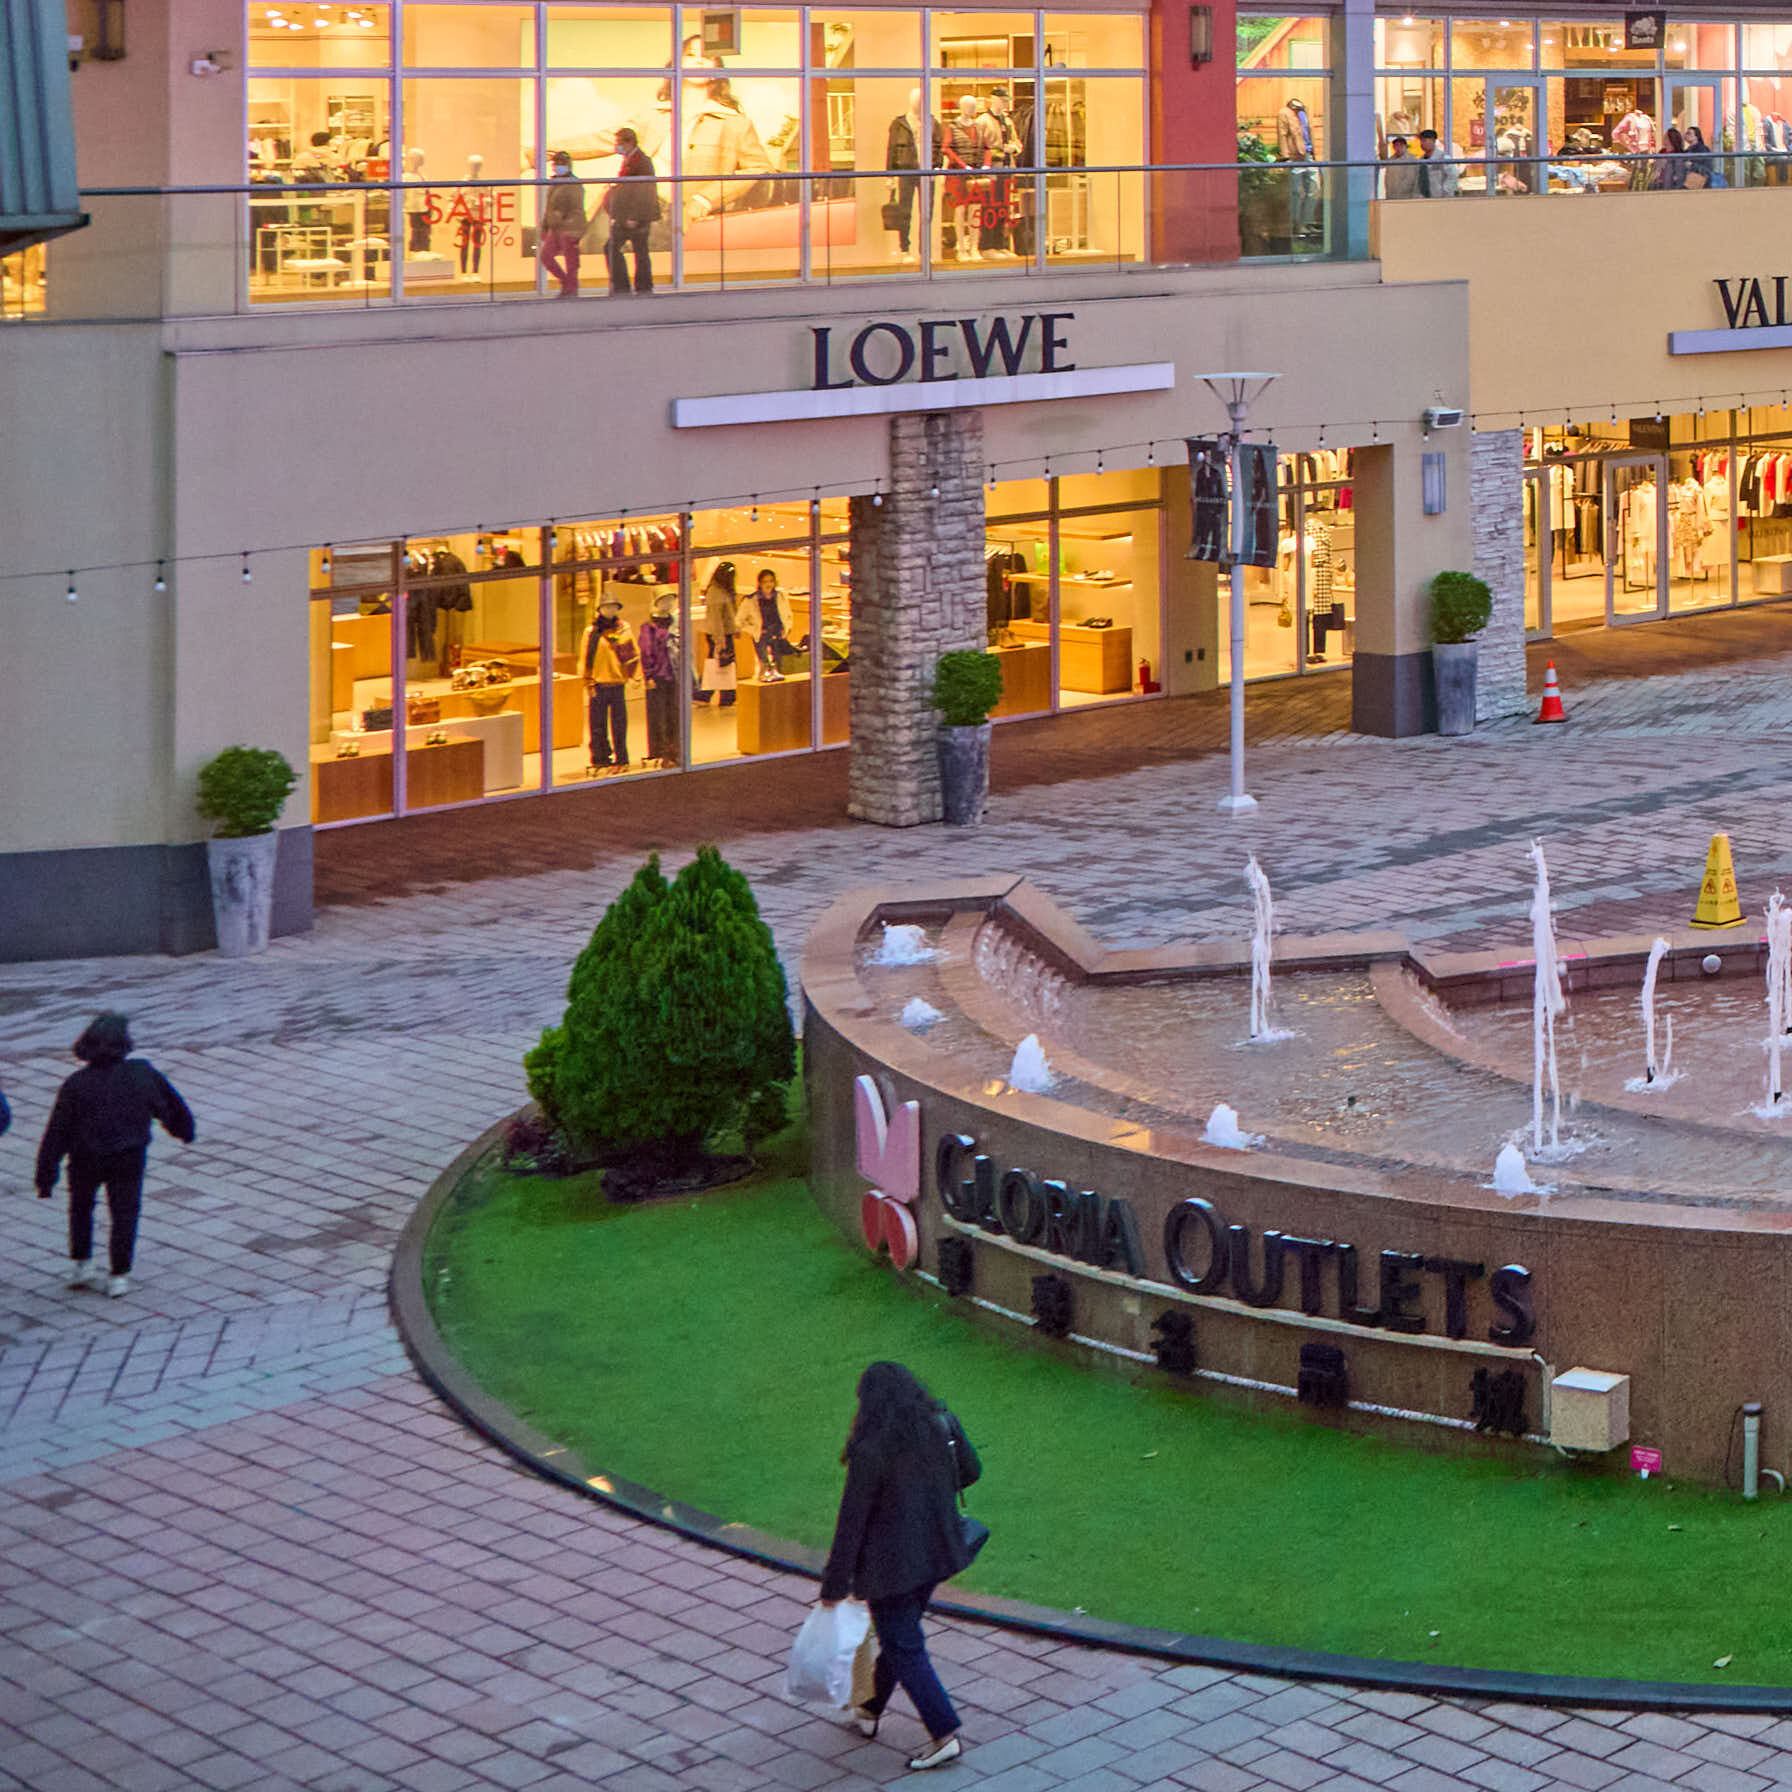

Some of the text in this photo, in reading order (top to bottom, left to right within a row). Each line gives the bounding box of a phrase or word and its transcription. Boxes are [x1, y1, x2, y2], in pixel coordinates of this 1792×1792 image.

[421, 192, 515, 224] SALE
[944, 178, 1020, 208] SALE
[811, 313, 1076, 390] LOEWE
[936, 1133, 1536, 1346] GLORIA OUTLETS
